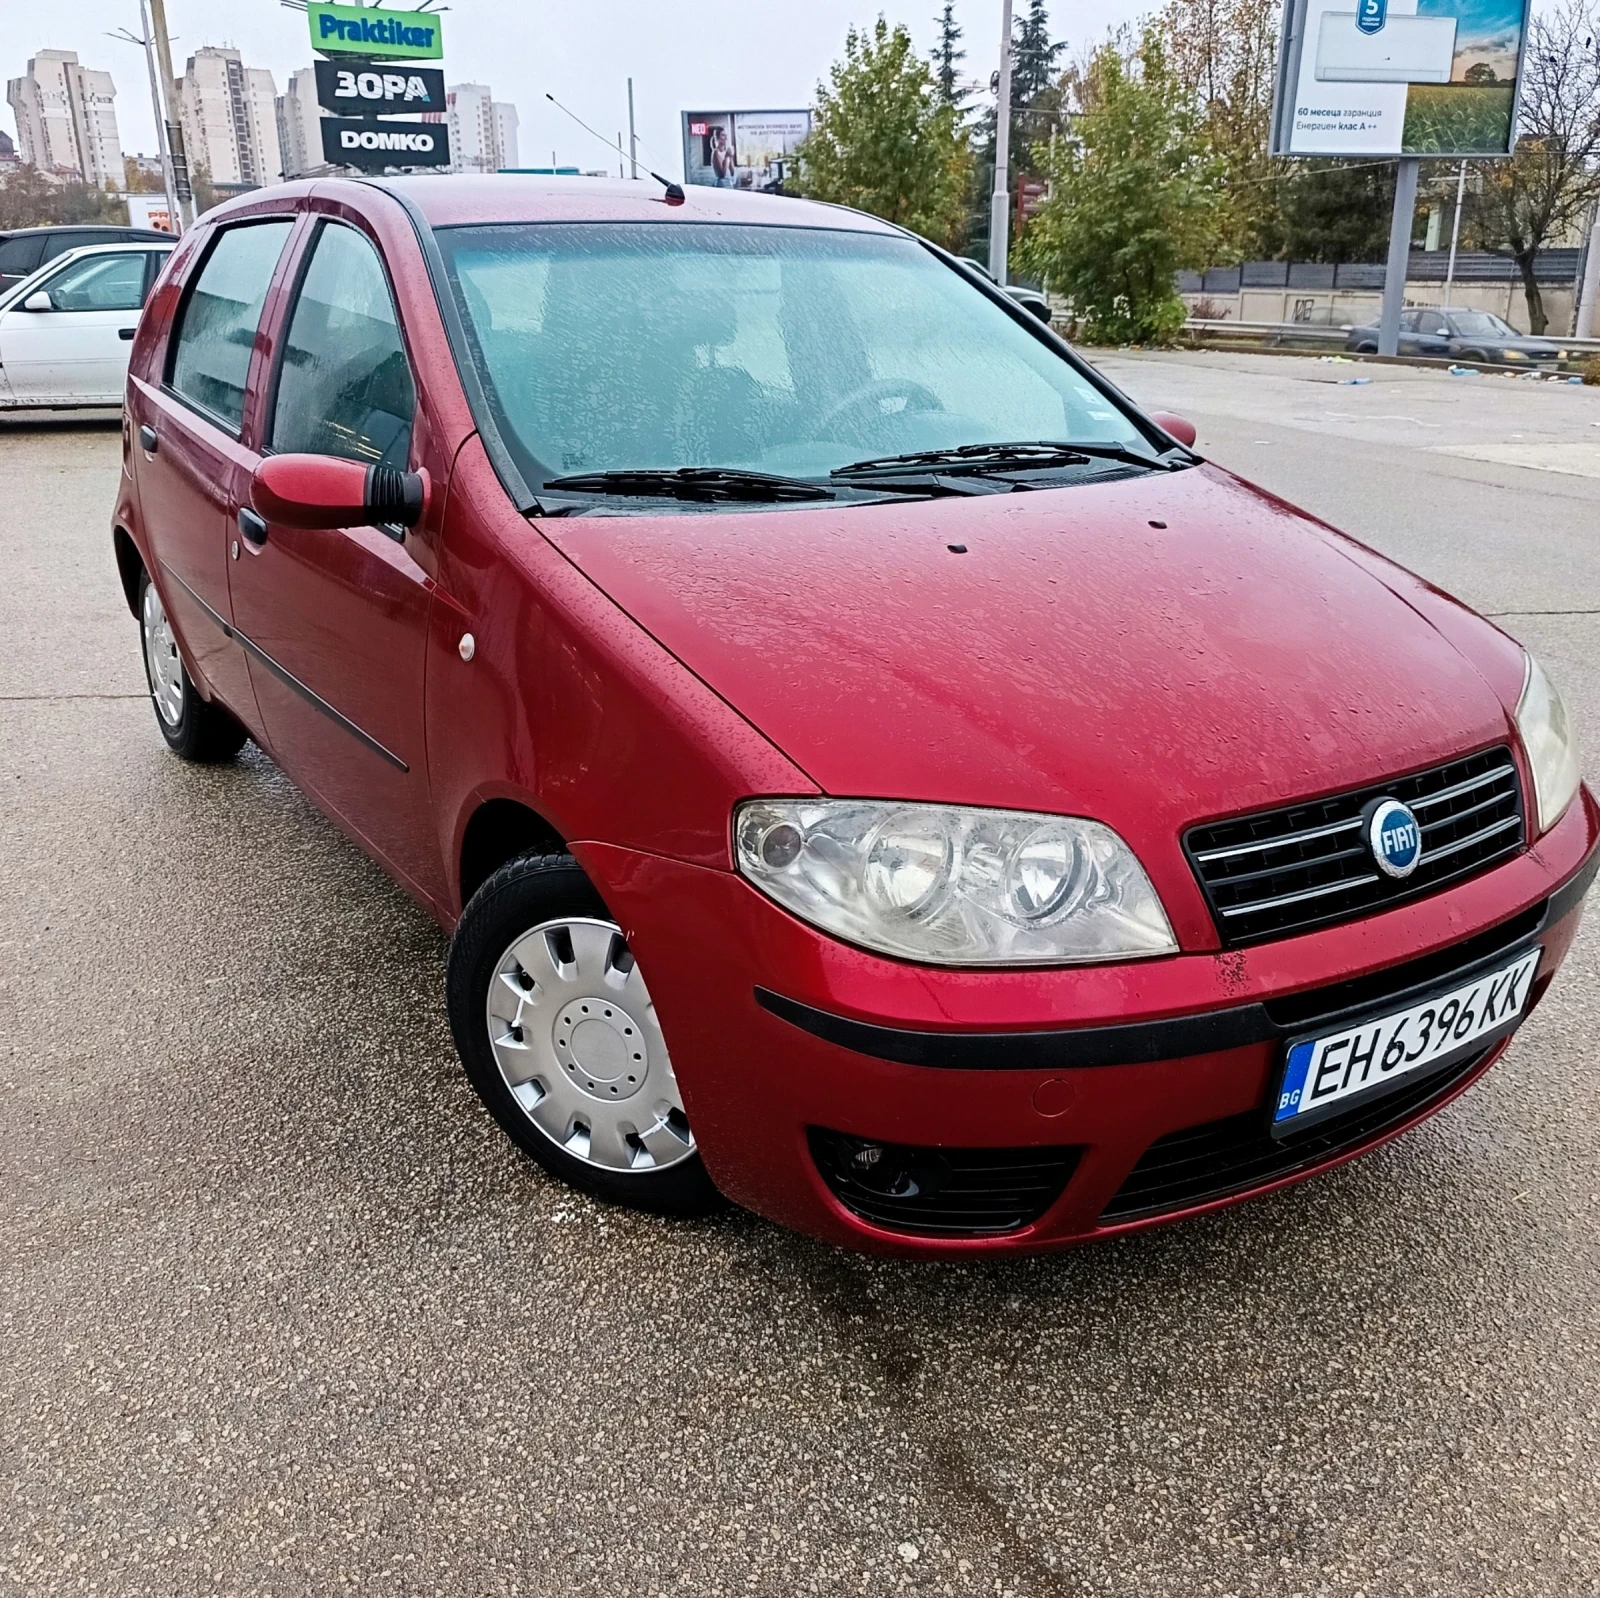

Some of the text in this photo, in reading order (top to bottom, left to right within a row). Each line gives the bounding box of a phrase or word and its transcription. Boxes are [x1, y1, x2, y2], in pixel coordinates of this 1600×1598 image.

[1365, 0, 1379, 15] 5
[319, 13, 435, 48] Praktiker
[335, 71, 431, 102] ЗОРА
[1297, 107, 1382, 118] 60 месеца гаранция
[1296, 121, 1336, 131] Енергиен
[1338, 121, 1358, 131] клас
[340, 131, 434, 152] DOMKO
[1382, 824, 1415, 855] FIAT
[1279, 1088, 1301, 1109] BG
